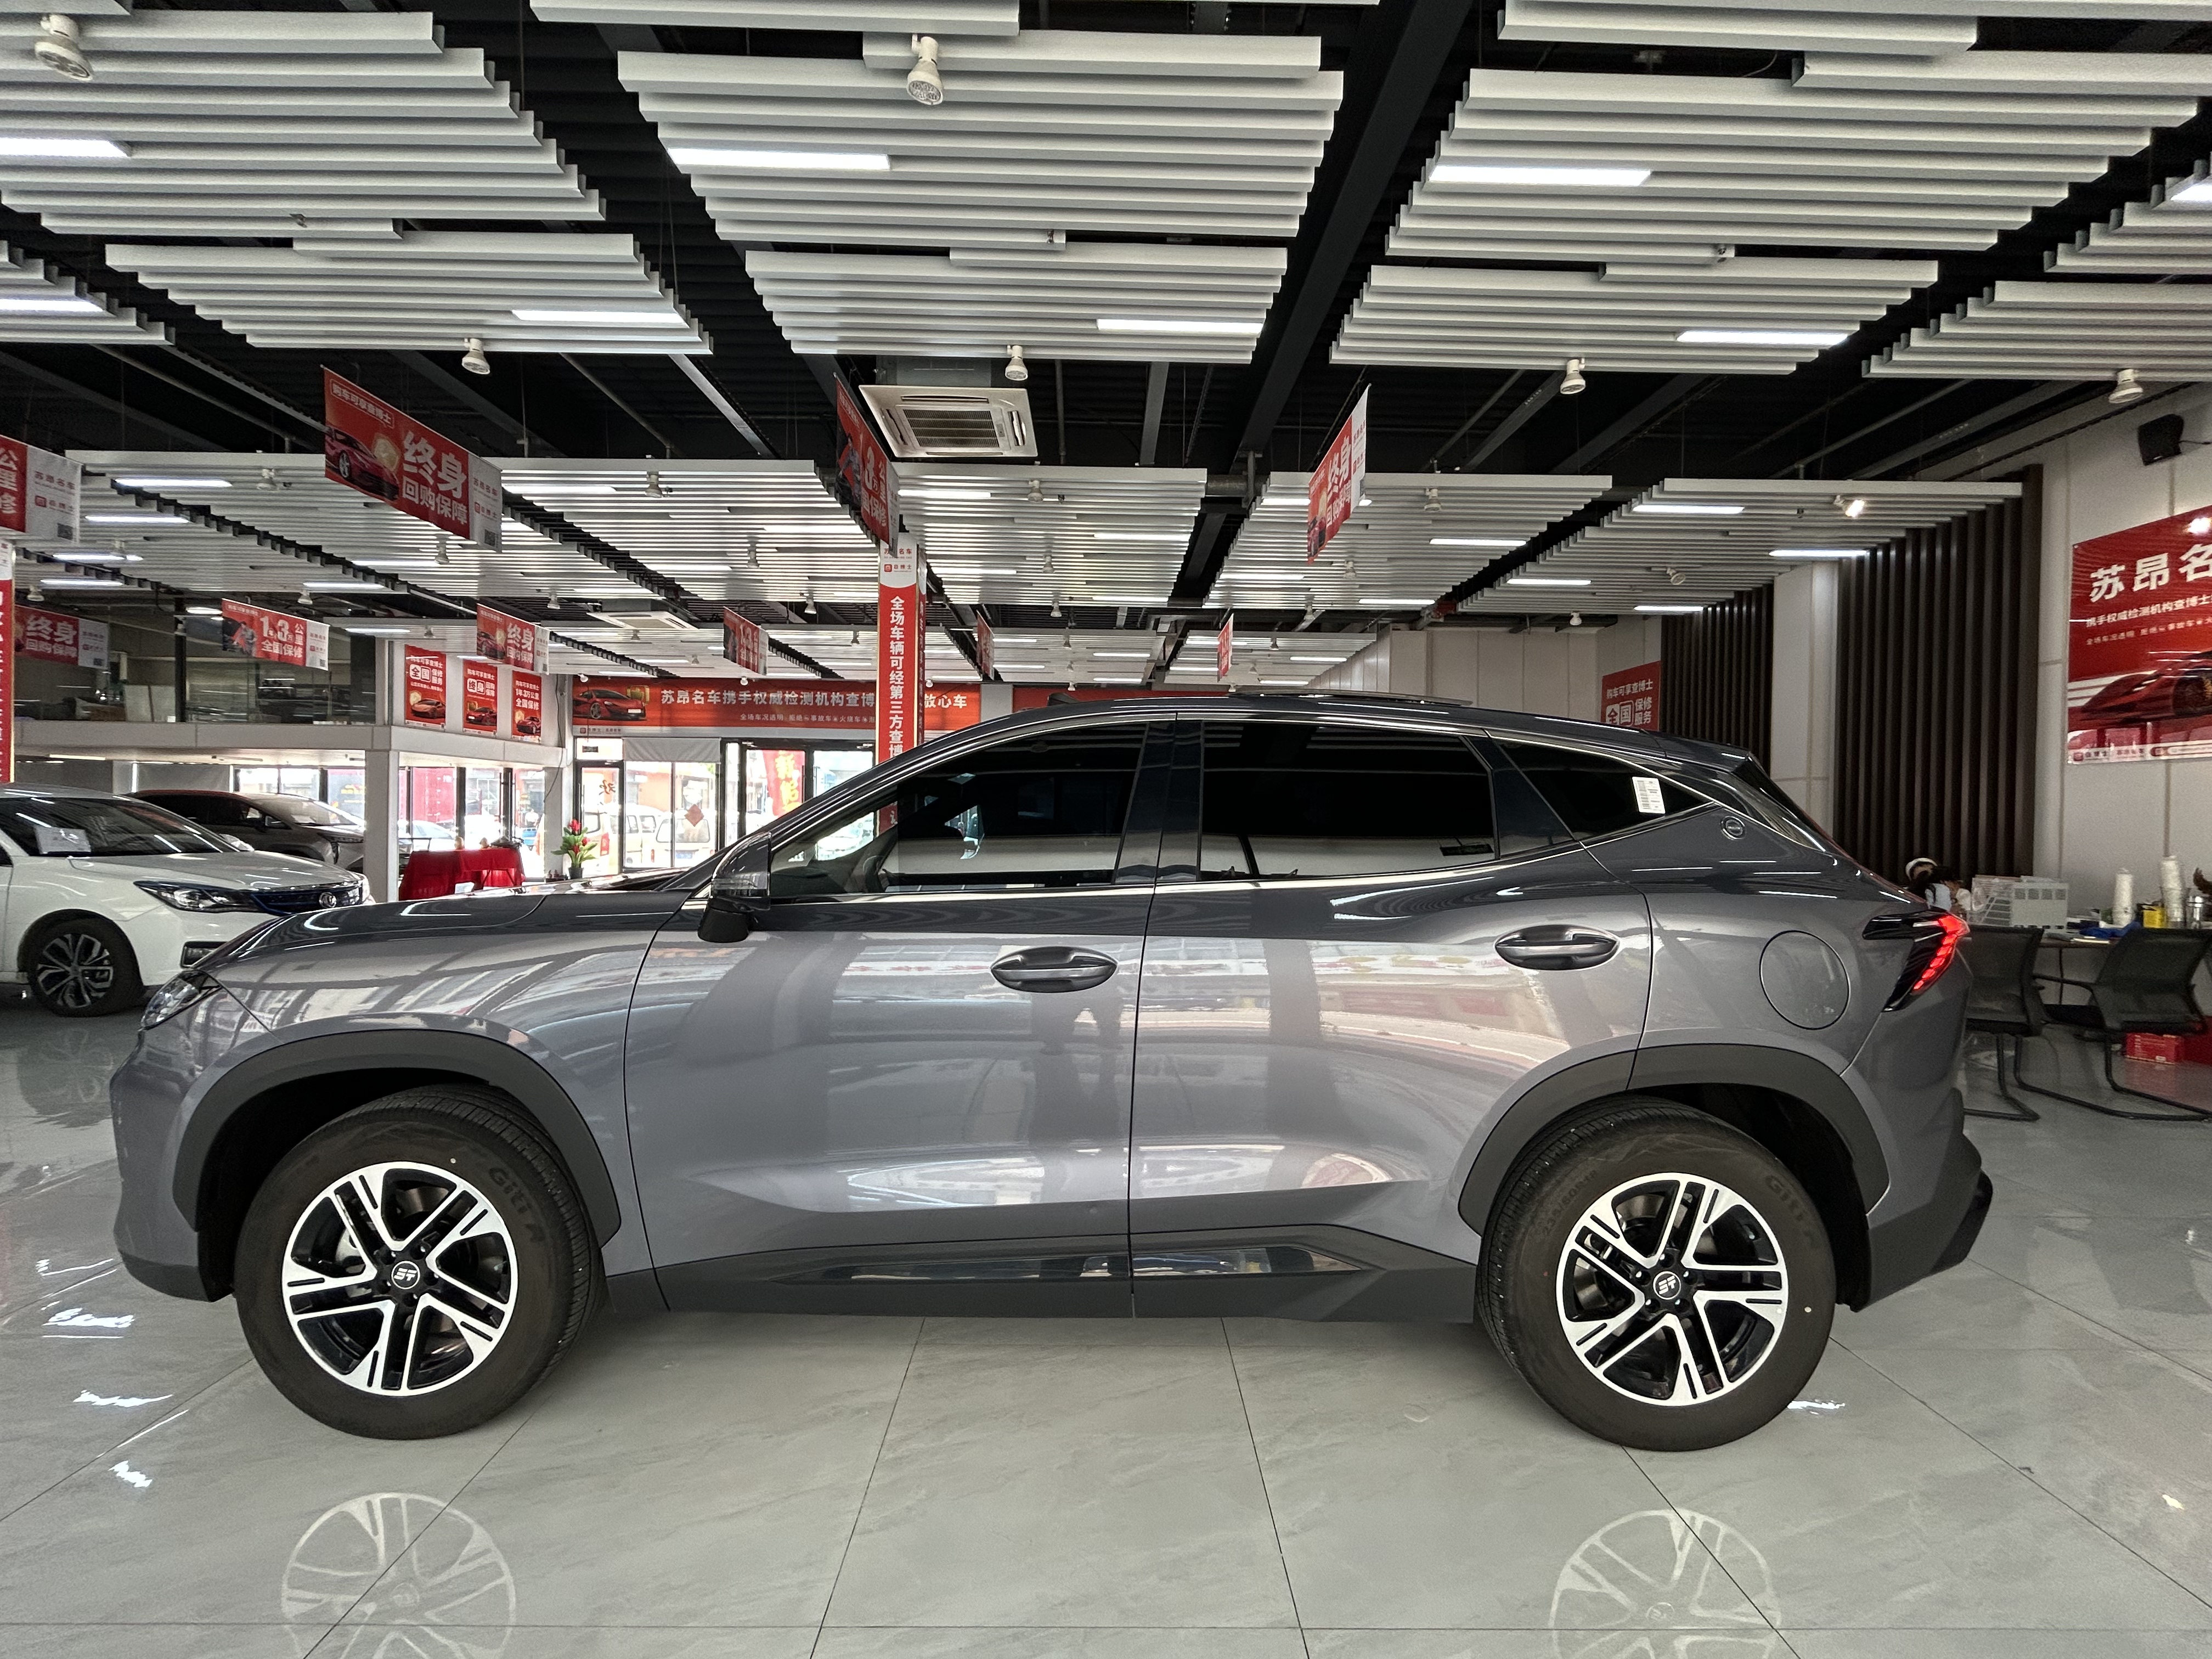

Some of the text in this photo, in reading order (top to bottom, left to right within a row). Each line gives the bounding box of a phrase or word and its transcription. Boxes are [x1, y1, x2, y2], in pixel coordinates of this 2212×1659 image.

[403, 431, 466, 499] 终身
[1328, 435, 1351, 506] 终身
[403, 475, 468, 524] 回购保障
[26, 614, 77, 645] 终身
[506, 622, 534, 651] 终身
[26, 638, 77, 658] 回购保障
[261, 639, 302, 658] 全国保修
[506, 646, 534, 664] 回购保障
[412, 667, 430, 680] 全国
[469, 680, 484, 693] 终身
[516, 697, 539, 710] 全国保修
[661, 689, 967, 709] 苏昂名车携手权威检测机构查博 放心车
[1607, 696, 1652, 725] 全国 保修
